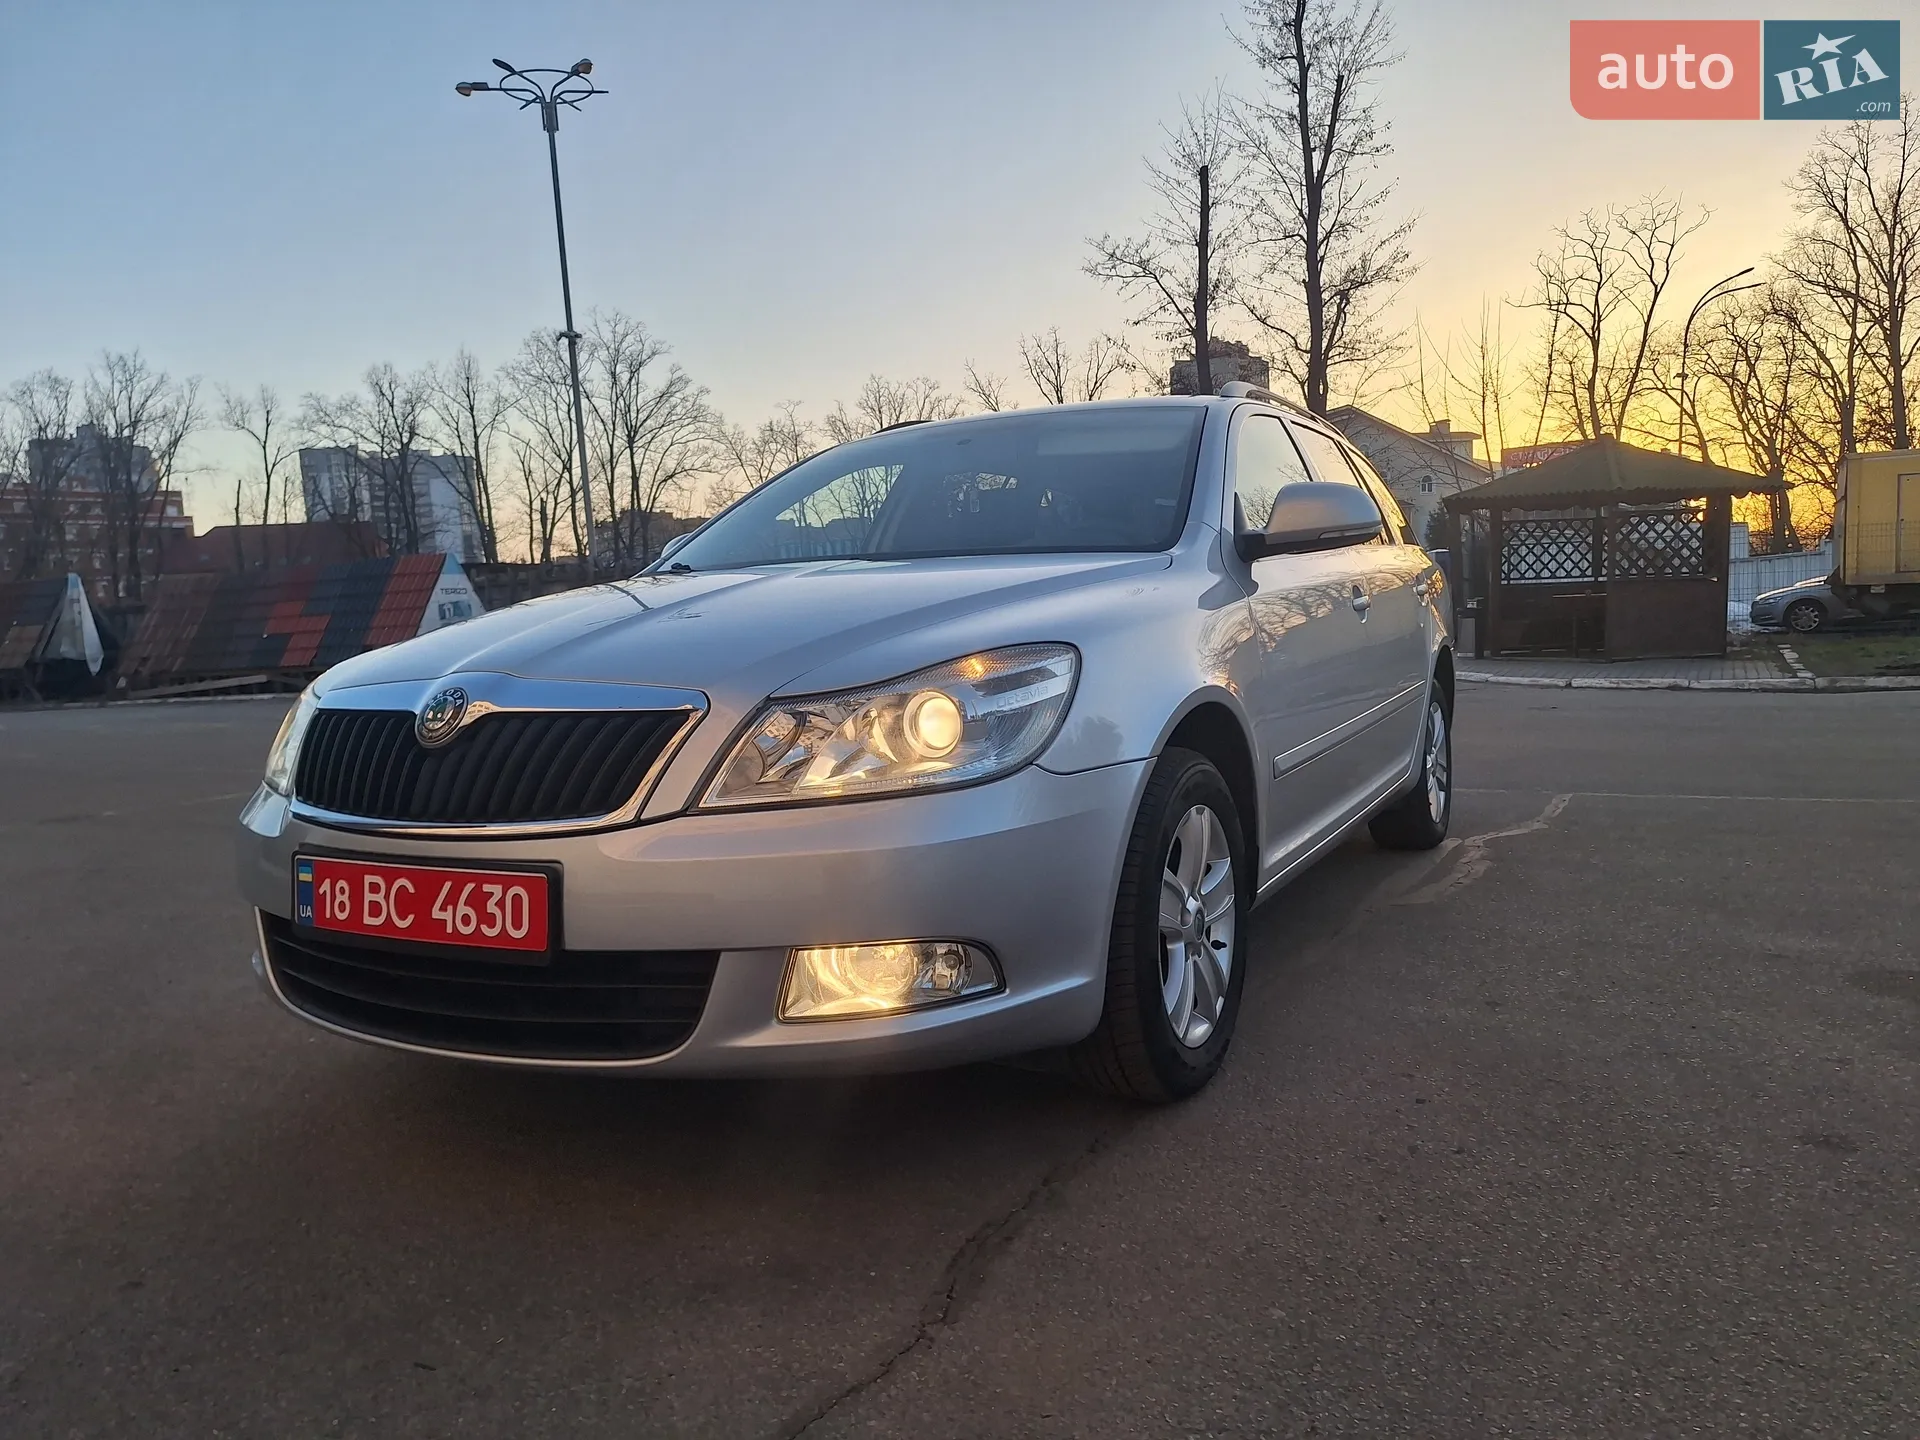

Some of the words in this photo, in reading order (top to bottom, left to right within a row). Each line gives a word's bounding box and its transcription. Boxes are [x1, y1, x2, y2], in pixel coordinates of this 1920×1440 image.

[299, 904, 313, 919] UA
[317, 878, 351, 921] 18
[362, 874, 416, 929] BC
[431, 880, 530, 939] 4630
